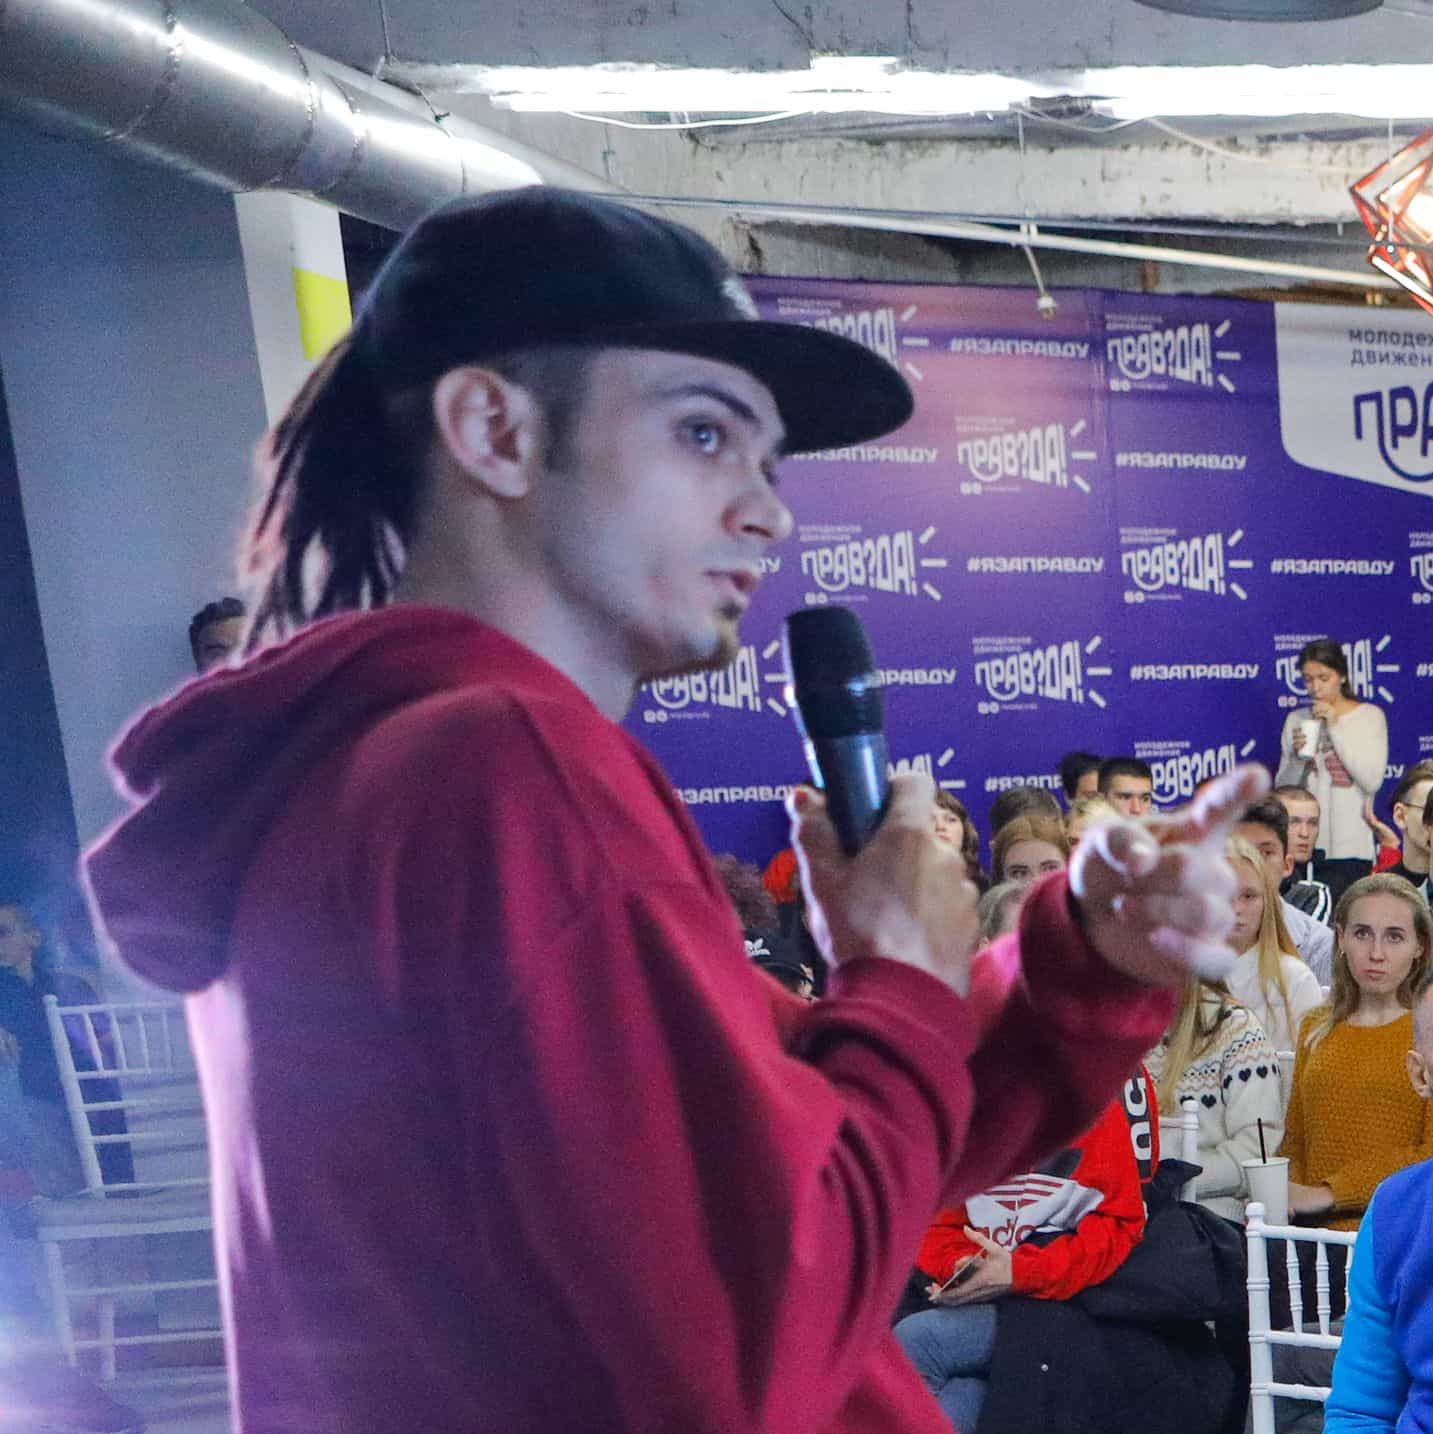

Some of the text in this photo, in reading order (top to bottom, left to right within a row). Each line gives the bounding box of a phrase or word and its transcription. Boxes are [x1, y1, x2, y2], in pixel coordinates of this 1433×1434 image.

[1106, 323, 1213, 388] ПРАВ?ДА!
[957, 423, 1068, 488] ПРАВ?ДА!
[801, 531, 917, 596] ПРАВ?ДА!
[967, 557, 1104, 572] #ЯЗАПРАВДУ
[1121, 532, 1226, 595] ПРАВ?ДА!
[1271, 559, 1395, 575] #ЯЗАПРАВДУ
[974, 640, 1084, 703] ПРАВ?ДА!
[1130, 664, 1260, 680] #ЯЗАПРАВДУ
